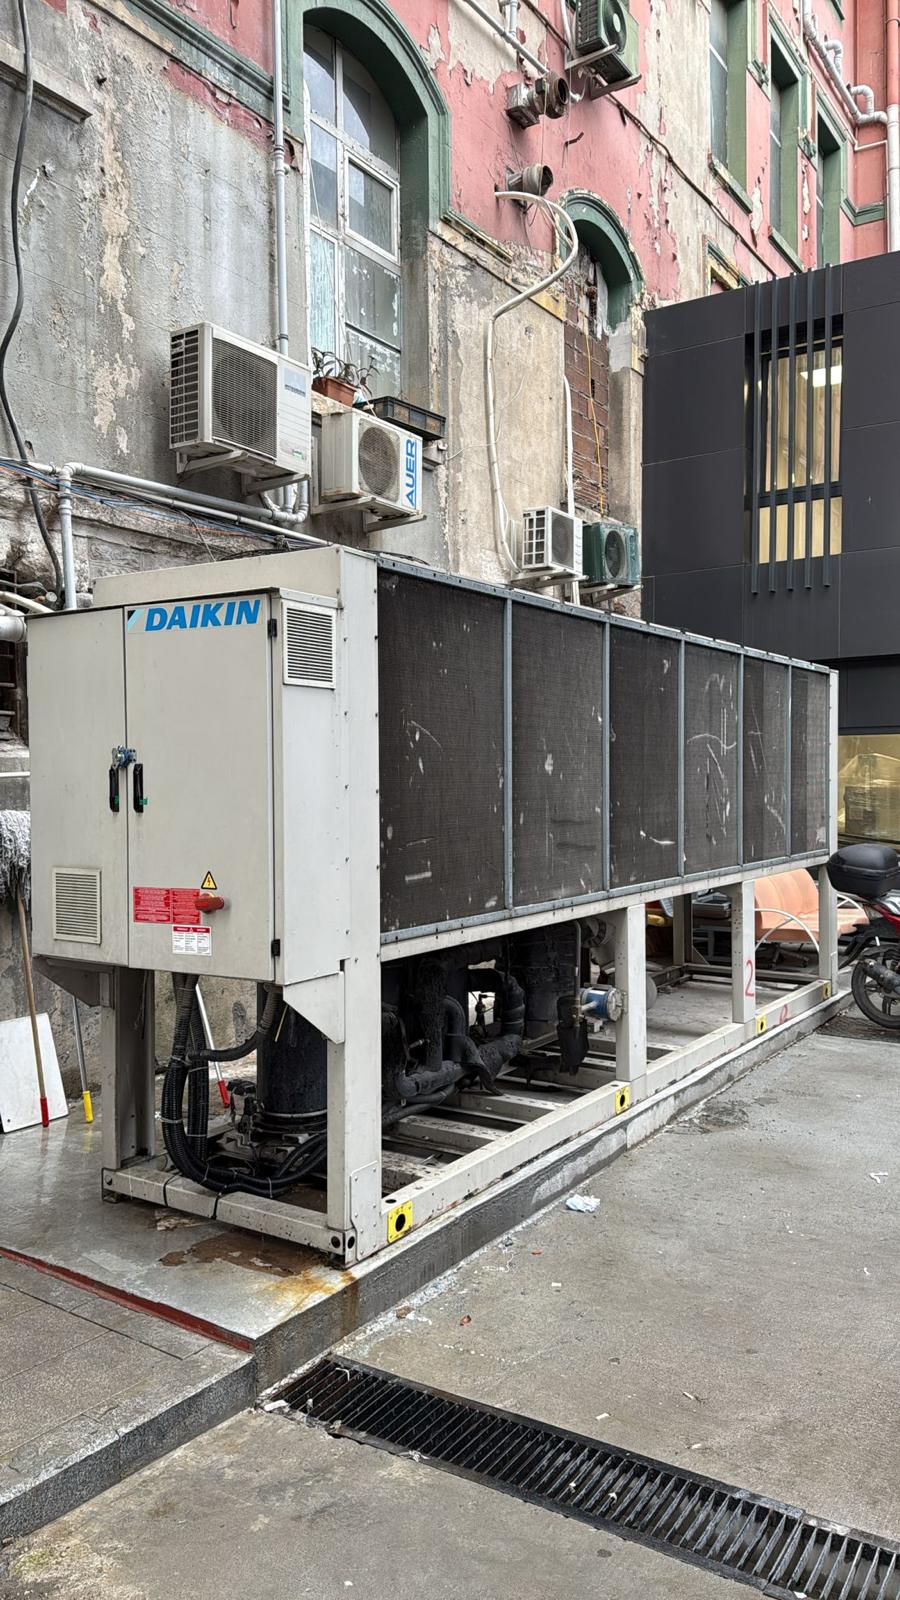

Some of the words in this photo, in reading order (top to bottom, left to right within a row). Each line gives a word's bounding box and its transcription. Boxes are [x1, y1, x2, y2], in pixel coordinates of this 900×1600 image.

[405, 438, 415, 507] AUER
[144, 599, 261, 632] DAIKIN
[744, 959, 755, 997] 2
